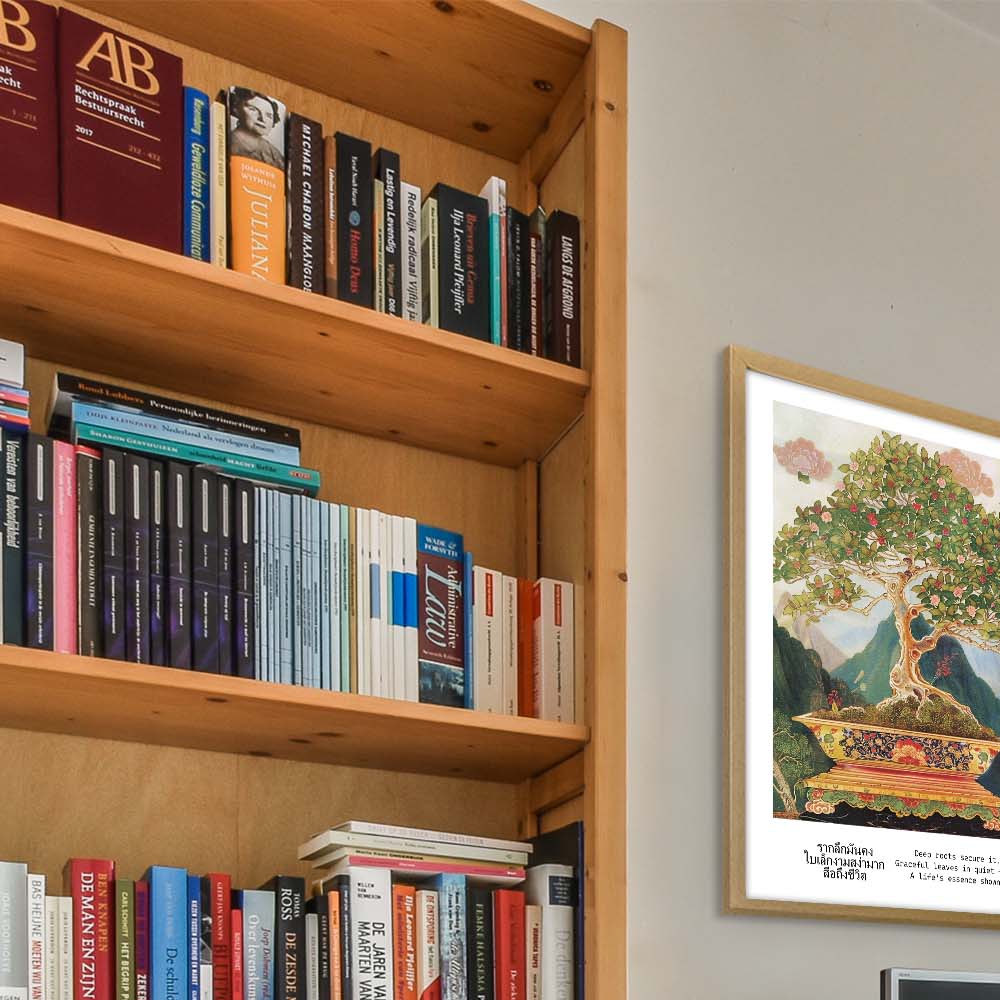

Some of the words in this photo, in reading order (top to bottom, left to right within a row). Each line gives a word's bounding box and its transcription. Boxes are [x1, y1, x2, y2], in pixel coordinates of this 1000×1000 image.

[76, 32, 161, 96] AB
[74, 84, 137, 116] Rechtspraak
[74, 96, 146, 129] Bestuursrecht
[75, 125, 94, 137] 2017
[302, 124, 312, 177] MICHAEL
[191, 142, 207, 198] Geweldloze
[385, 168, 396, 197] Lastig
[302, 180, 312, 228] CHABON
[386, 198, 394, 210] en
[406, 192, 417, 233] Redelijk
[450, 208, 464, 226] Ilja
[350, 228, 361, 263] Homo
[386, 210, 396, 254] Levendig
[407, 234, 417, 276] radicaal
[453, 226, 464, 272] Leonard
[561, 235, 573, 264] LANGS
[350, 265, 361, 294] Deus
[562, 264, 572, 276] DE
[406, 280, 418, 310] Vijftig
[450, 272, 464, 314] Pfeijffer
[562, 277, 574, 318] AFGROND
[150, 400, 203, 418] Persoonlijke
[206, 413, 266, 433] herinneringen
[162, 424, 201, 438] Nederland
[90, 430, 126, 442] SHARON
[6, 440, 20, 476] Vereisten
[6, 478, 18, 493] van
[425, 536, 446, 548] WADE
[424, 563, 462, 648] Law
[448, 564, 460, 650] Administrative
[895, 860, 929, 869] Graceful
[934, 862, 958, 871] leaves
[974, 866, 995, 875] quiet
[914, 850, 932, 858] Deep
[936, 852, 956, 860] roots
[32, 880, 42, 900] BAS
[81, 872, 94, 892] DE
[98, 872, 108, 896] BEN
[910, 872, 914, 880] A
[919, 872, 944, 882] life's
[948, 876, 976, 884] essence
[282, 888, 292, 920] ROSS
[405, 895, 414, 912] Ilja
[427, 895, 434, 903] DE
[32, 902, 42, 937] HEIJNE
[81, 896, 96, 934] MAN
[98, 903, 108, 952] KNAPEN
[248, 914, 258, 942] Over
[372, 922, 386, 936] DE
[427, 904, 435, 944] ONTSPORING
[476, 904, 484, 938] FEMKE
[262, 928, 271, 946] Joep
[285, 932, 296, 950] DE
[358, 921, 372, 974] MAARTEN
[406, 914, 414, 952] Leonard
[555, 930, 570, 950] De
[32, 940, 42, 970] MOETEN
[82, 938, 96, 959] EN
[166, 948, 178, 965] De
[372, 943, 386, 980] JAREN
[32, 971, 42, 984] WIJ
[80, 962, 96, 998] ZIJN
[121, 960, 129, 992] BEGRIP
[286, 953, 297, 992] ZESDE
[476, 940, 484, 992] HALSEMA
[32, 986, 42, 1000] VAN
[359, 980, 372, 1000] VAN
